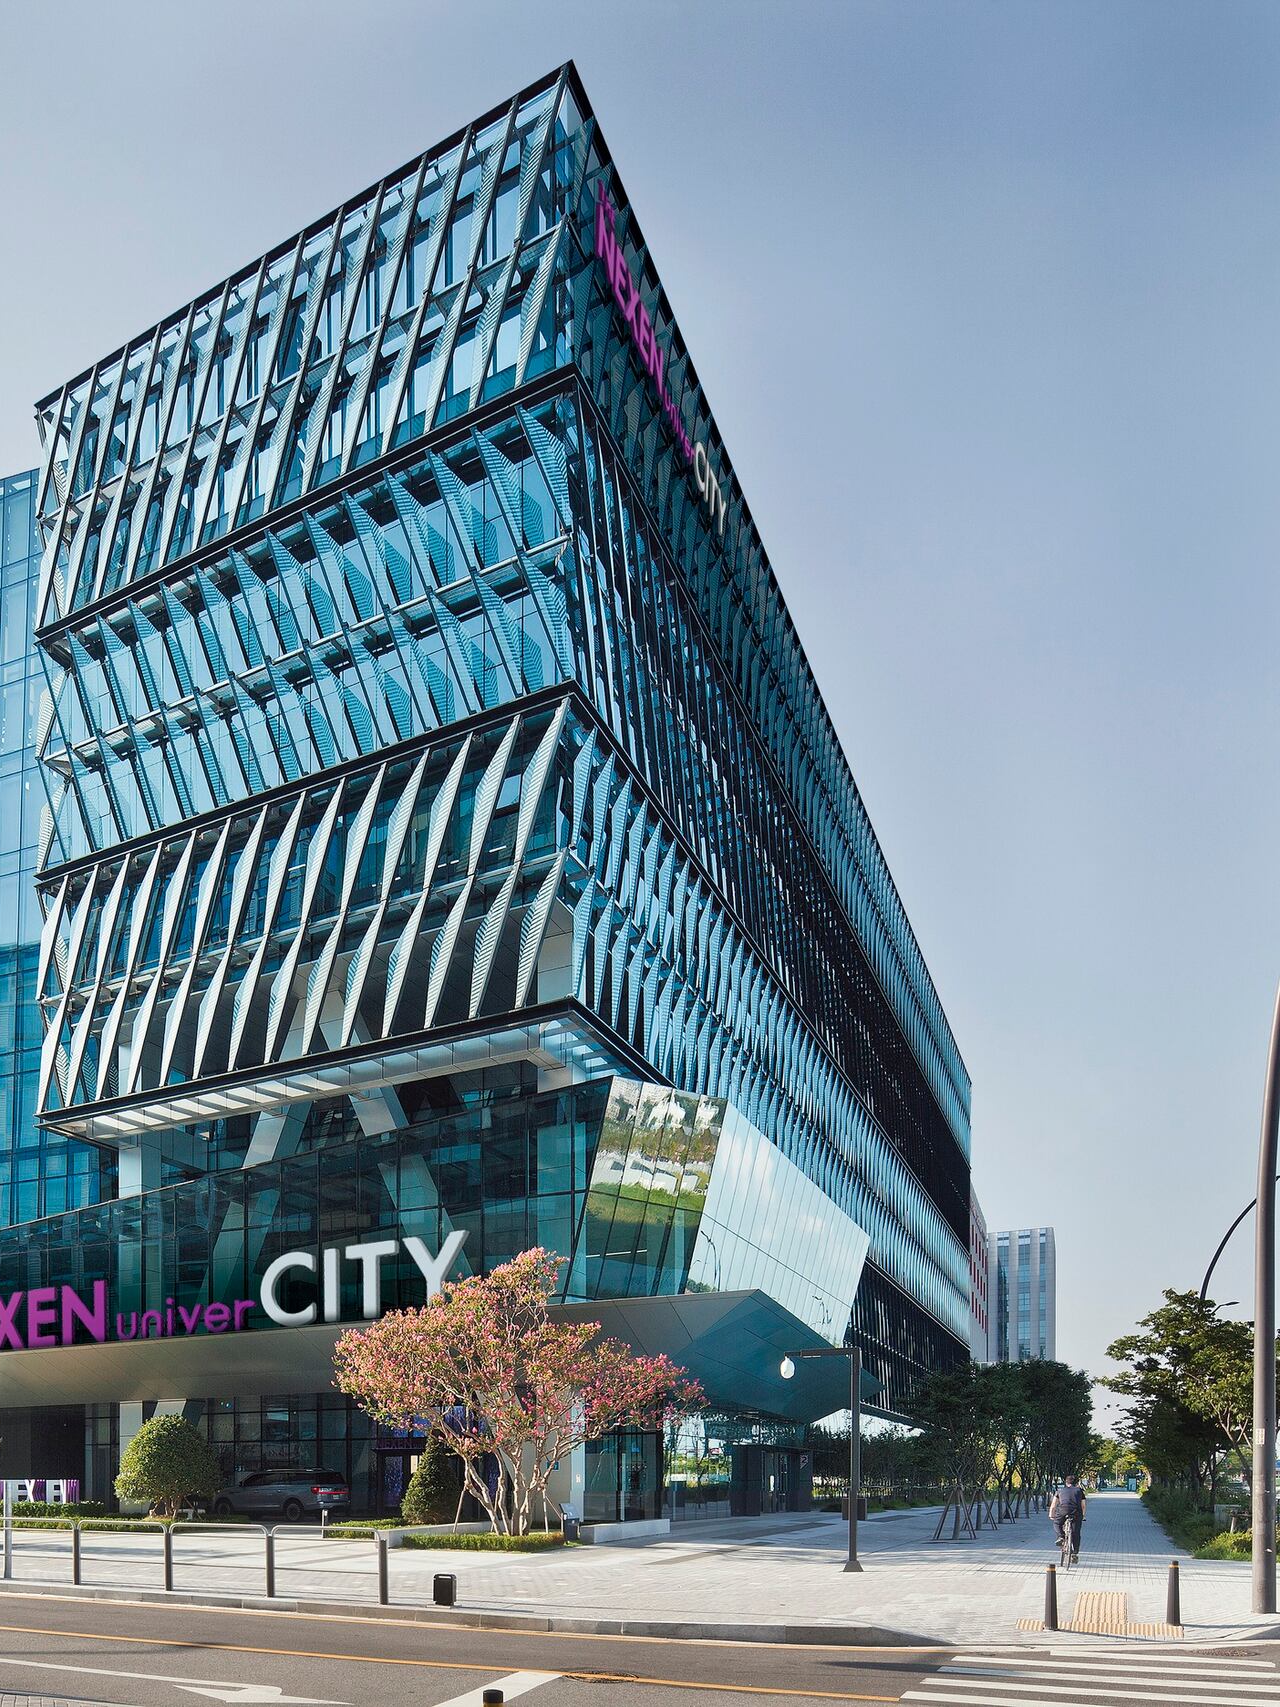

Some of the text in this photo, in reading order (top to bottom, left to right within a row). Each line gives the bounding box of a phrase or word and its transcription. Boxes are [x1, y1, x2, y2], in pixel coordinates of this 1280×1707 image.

[596, 202, 663, 395] NEXEN
[694, 442, 727, 535] CITY
[116, 1297, 256, 1340] univer
[260, 1230, 469, 1327] CITY
